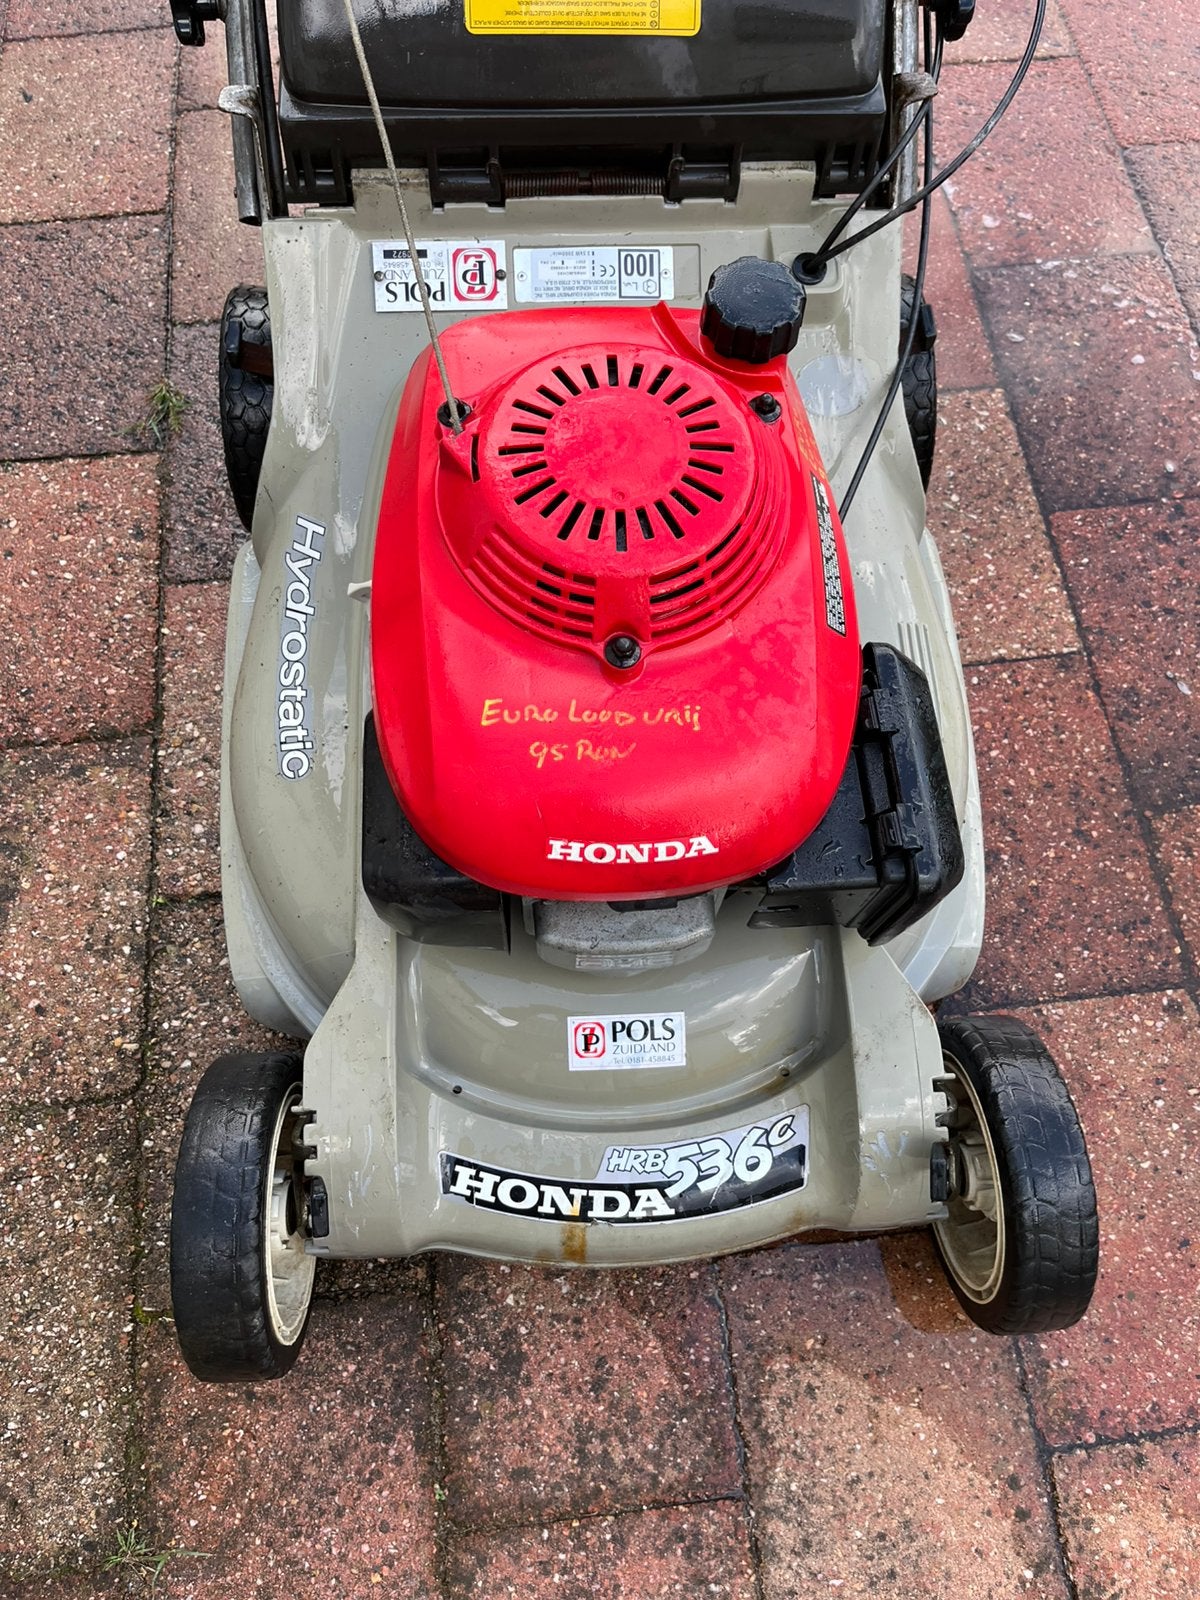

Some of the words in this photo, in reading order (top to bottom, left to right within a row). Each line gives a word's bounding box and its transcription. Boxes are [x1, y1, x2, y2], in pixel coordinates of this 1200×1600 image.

[623, 253, 654, 277] 100
[385, 281, 446, 303] POLS
[278, 516, 326, 780] Hydrostatic
[547, 835, 720, 864] HONDA
[611, 1018, 675, 1043] POLS
[612, 1042, 676, 1055] ZUIDLAND
[449, 1164, 676, 1218] HONDA
